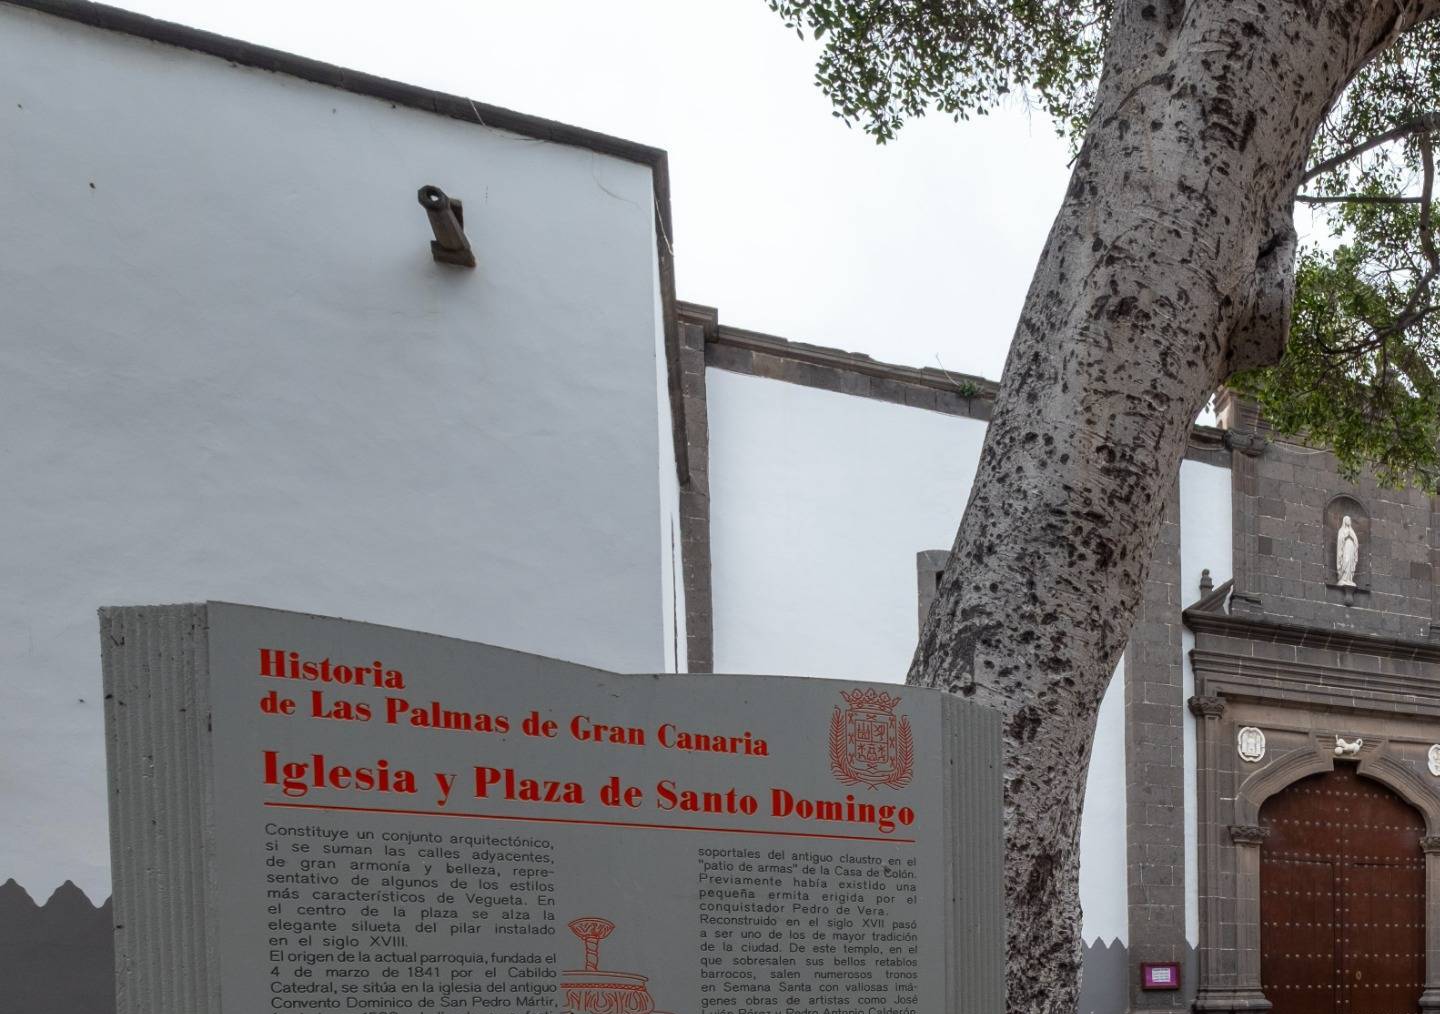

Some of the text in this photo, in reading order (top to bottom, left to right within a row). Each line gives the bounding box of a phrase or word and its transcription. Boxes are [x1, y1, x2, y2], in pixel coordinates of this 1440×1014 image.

[258, 648, 406, 689] Historia
[259, 690, 769, 758] de Las Palmas de Gran Canaria
[262, 750, 915, 834] Iglesia y Plaza de Santo Domingo
[264, 824, 349, 842] Constituye
[356, 831, 375, 841] un
[380, 831, 443, 845] conjunto
[264, 840, 555, 865] si se suman las calles adyacentes,
[264, 857, 555, 879] de gran armonía y belleza, repre-
[266, 873, 555, 892] sentativo de algunos de los estilos
[266, 888, 556, 907] más característicos de Vegueta. En
[266, 904, 556, 921] el centro de la plaza se alza la
[266, 919, 556, 936] elegante silueta del pilar instalado
[268, 935, 408, 950] en el siglo XVIII.
[268, 951, 557, 966] El origen de la actual parroquia, fundada el
[699, 956, 918, 968] que sobresalen sus bellos retablos
[269, 966, 558, 981] 4 de marzo de 1841 por el Cabildo
[769, 969, 801, 979] salen
[813, 971, 873, 979] numerosos
[884, 969, 919, 979] tronos
[269, 981, 558, 996] Catedral, se sitúa en la iglesia del antiguo
[700, 984, 716, 992] en
[722, 982, 772, 992] Semana
[778, 982, 812, 992] Santa
[818, 984, 839, 992] con
[844, 981, 889, 992] valiosas
[269, 997, 341, 1009] Convento
[345, 997, 414, 1009] Dominico
[416, 997, 436, 1008] de
[439, 996, 468, 1008] San
[471, 996, 512, 1008] Pedro
[700, 994, 919, 1008] genes obras de artistas como José
